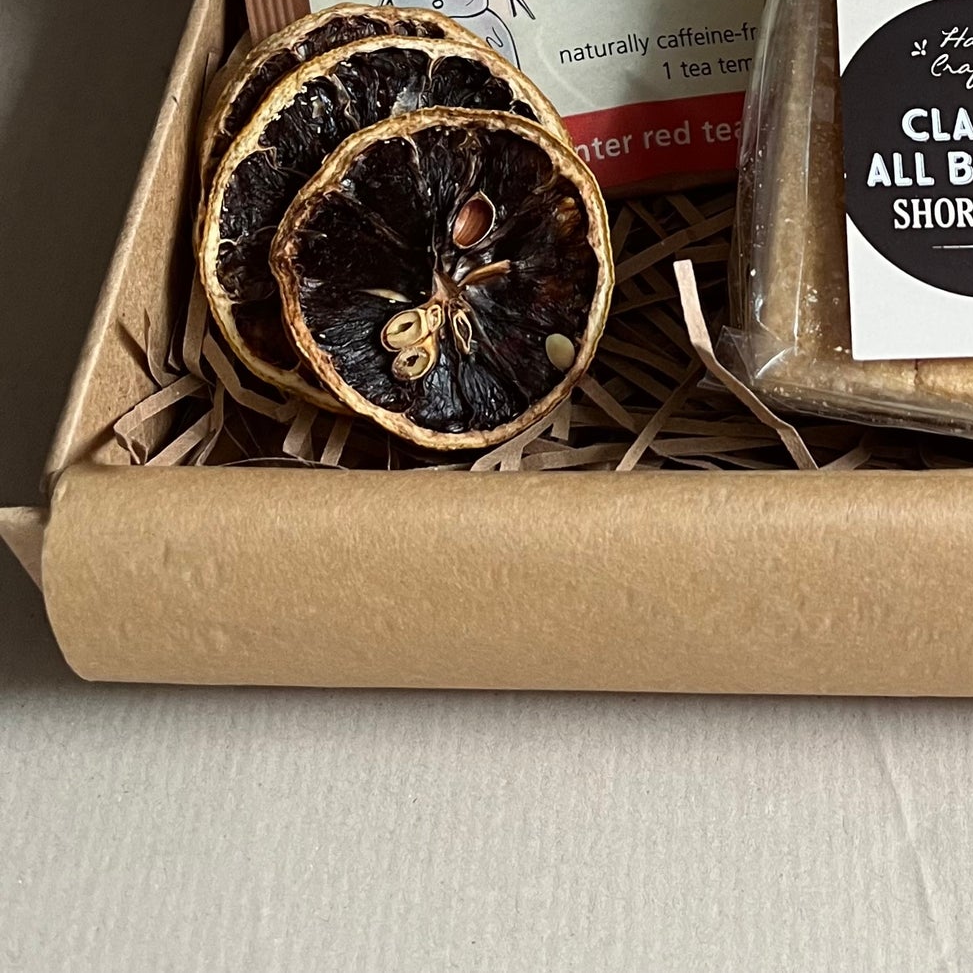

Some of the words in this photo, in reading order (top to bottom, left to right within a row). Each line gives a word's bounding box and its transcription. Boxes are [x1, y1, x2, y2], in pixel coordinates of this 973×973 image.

[559, 34, 650, 64] naturally
[657, 22, 758, 50] caffeine-fr
[662, 62, 671, 80] 1
[680, 60, 712, 78] tea
[572, 132, 632, 163] nter
[643, 120, 691, 149] red
[866, 152, 935, 187] ALL
